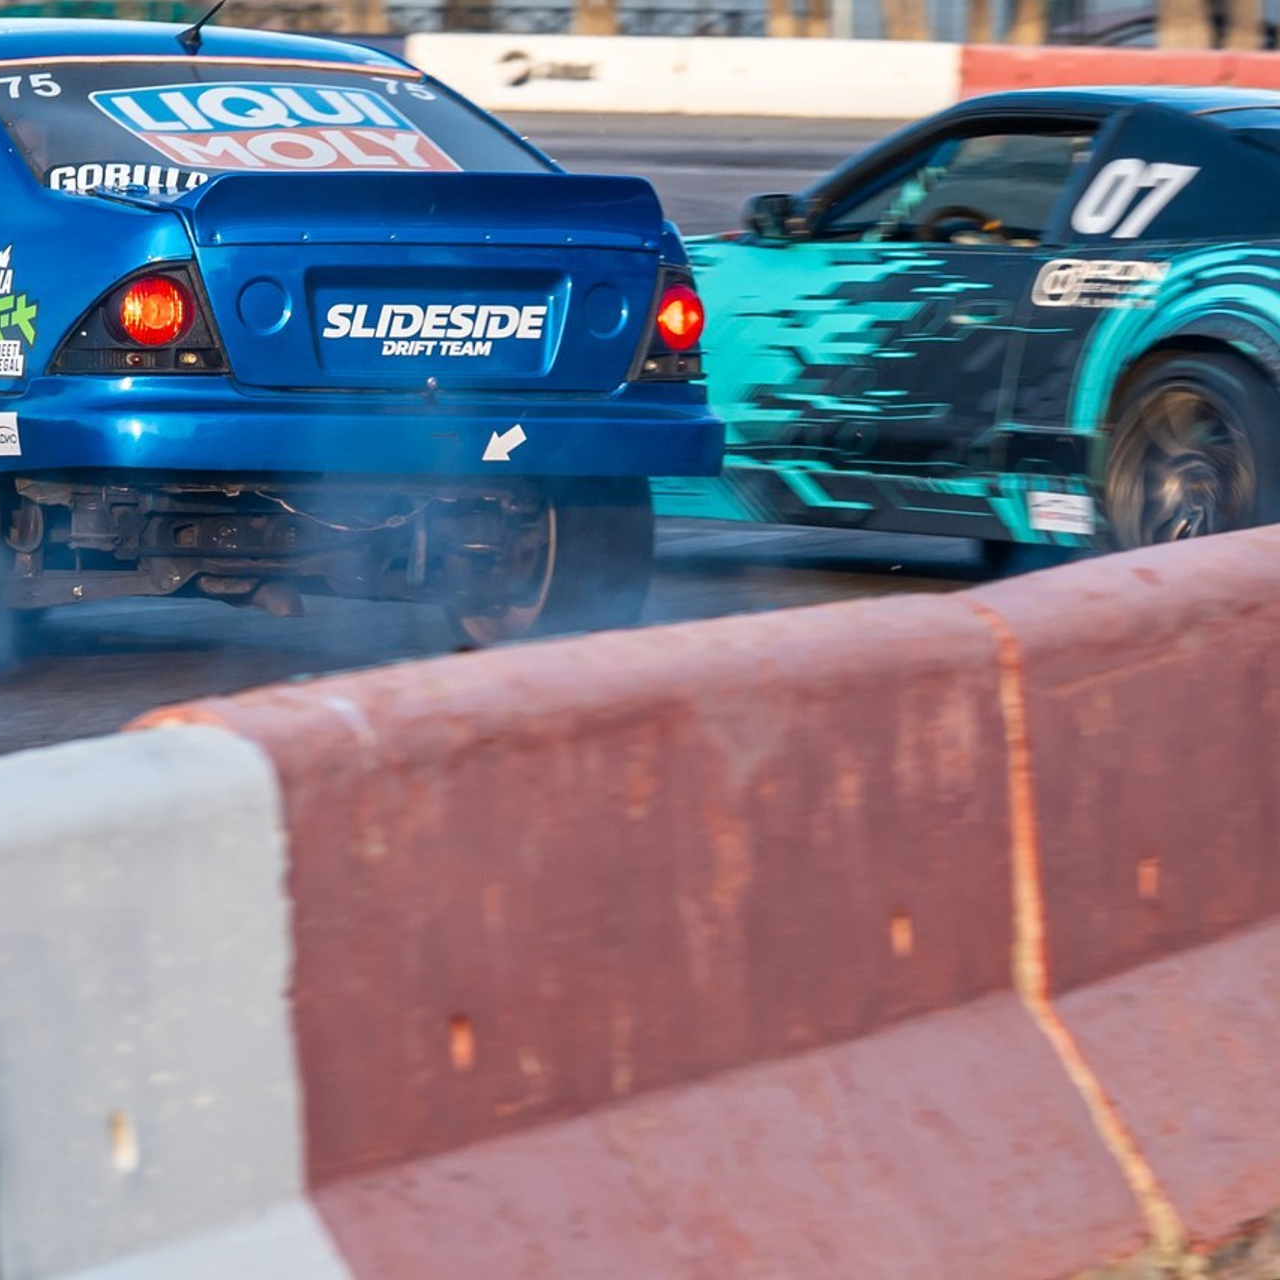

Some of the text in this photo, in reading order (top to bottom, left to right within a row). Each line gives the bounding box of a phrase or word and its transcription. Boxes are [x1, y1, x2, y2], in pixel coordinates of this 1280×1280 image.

[371, 76, 436, 101] 75
[111, 87, 398, 131] LIQUI
[156, 130, 431, 169] MOLY
[1070, 158, 1201, 239] 07
[322, 304, 547, 339] SLIDESIDE
[381, 340, 493, 357] DRIFT TEAM
